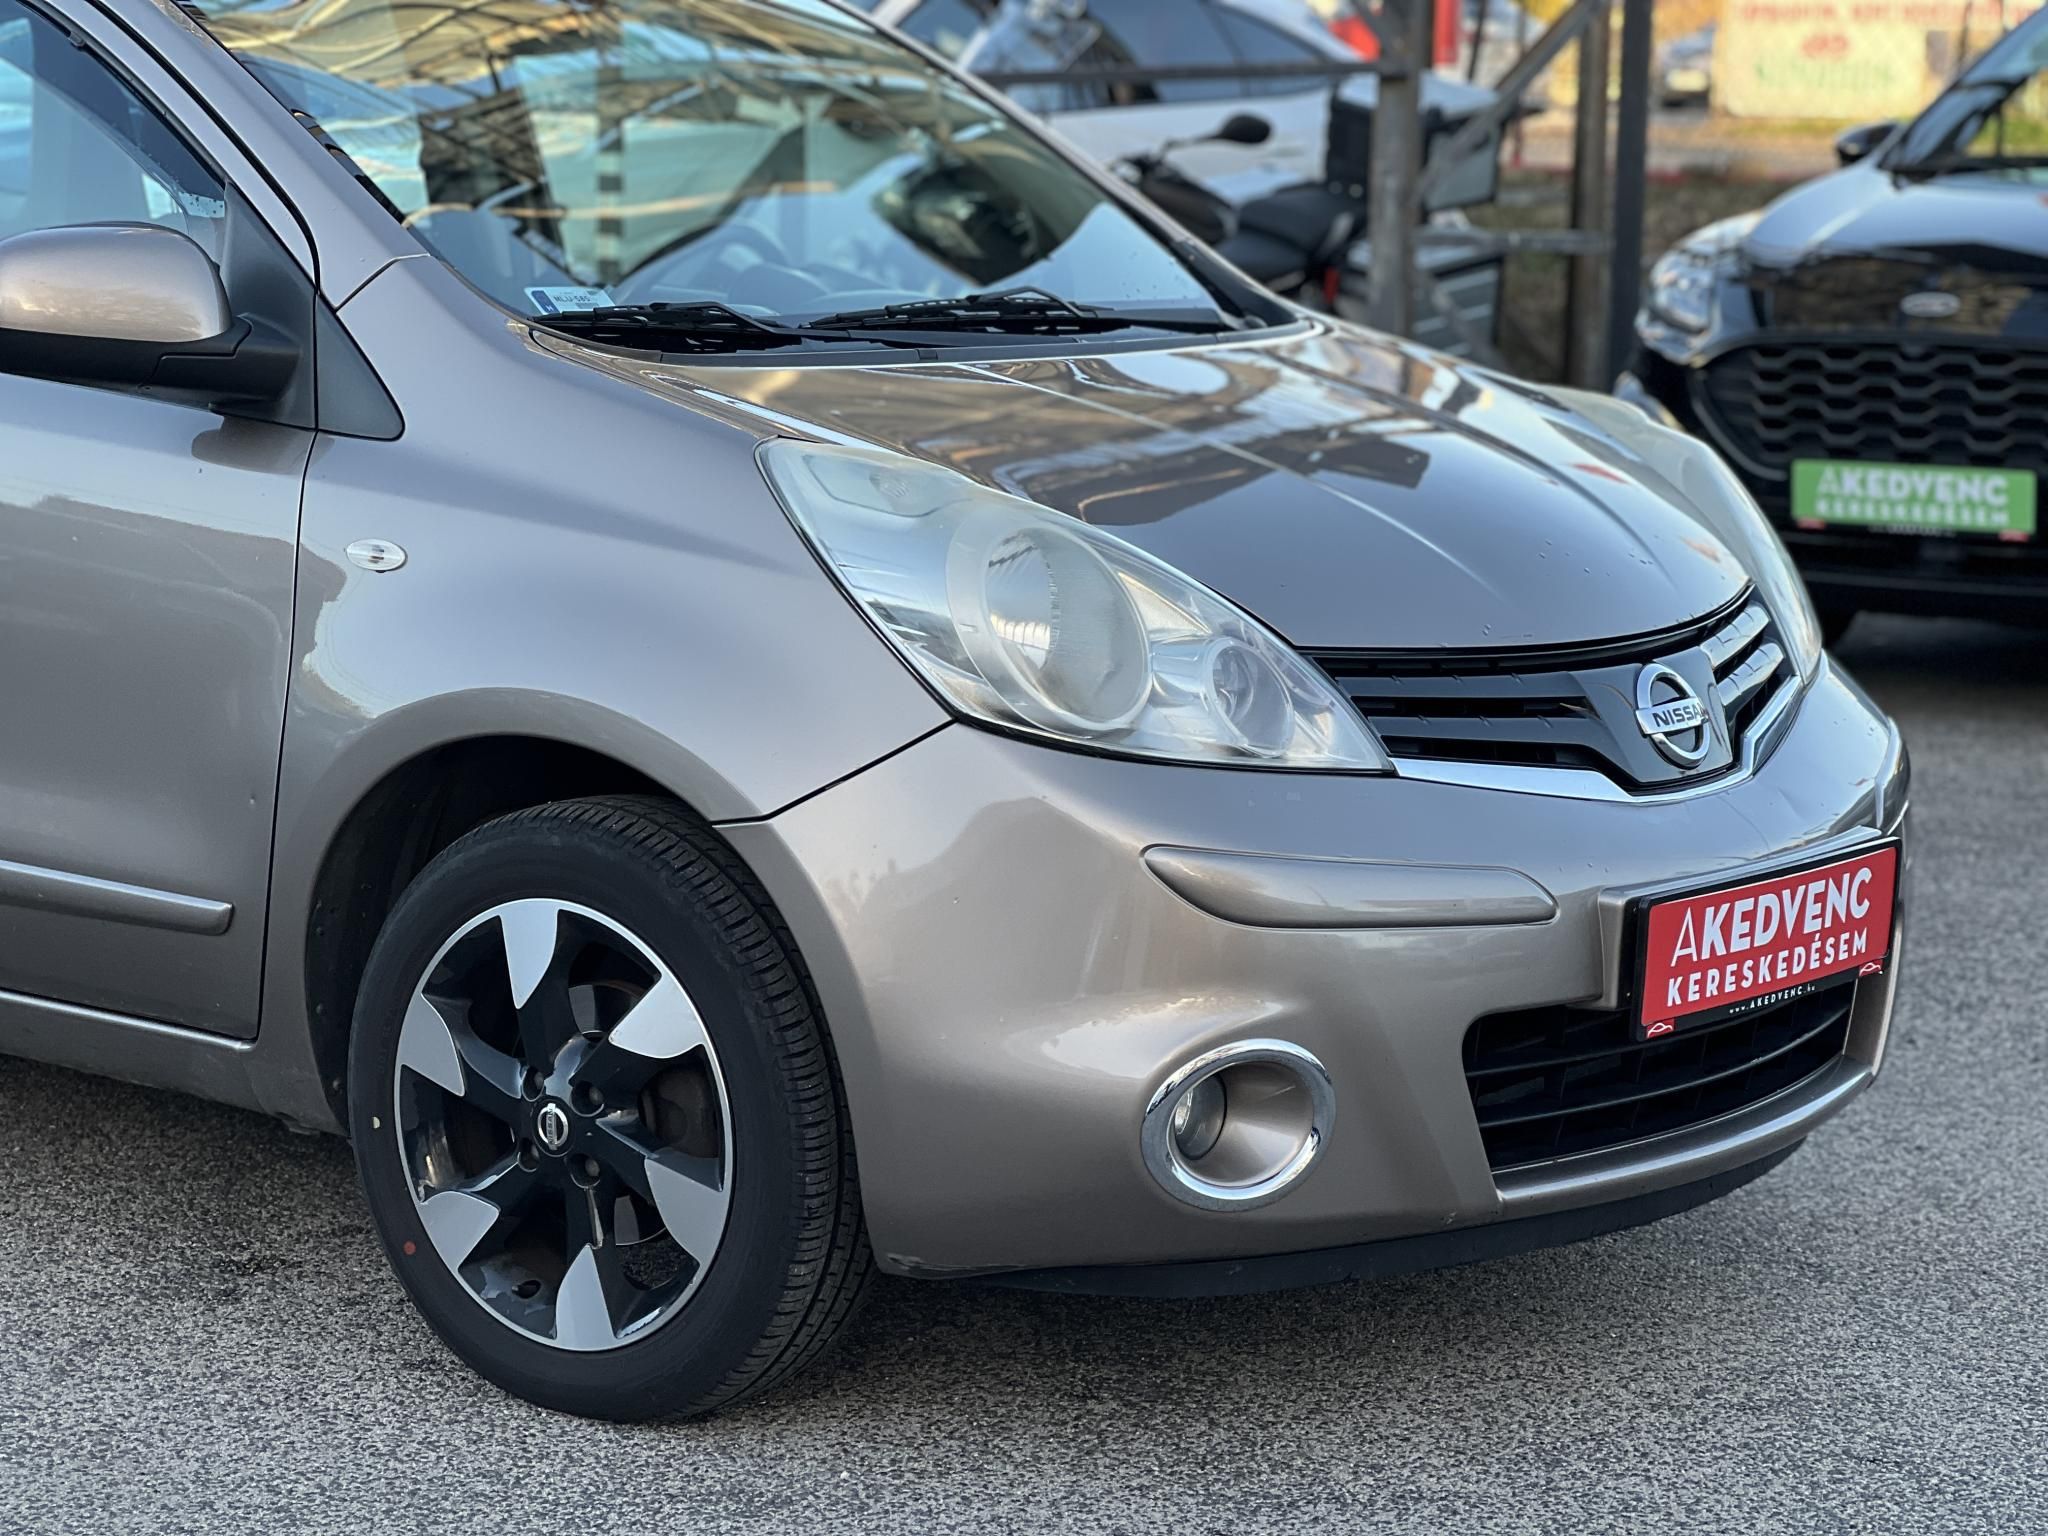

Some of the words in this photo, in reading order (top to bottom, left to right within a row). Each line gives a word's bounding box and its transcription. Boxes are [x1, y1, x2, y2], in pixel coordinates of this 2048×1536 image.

[1818, 466, 2009, 506] AKEDVENC
[1671, 867, 1872, 967] AKEDVENC
[1667, 927, 1867, 1007] KERESKEDÉSEM
